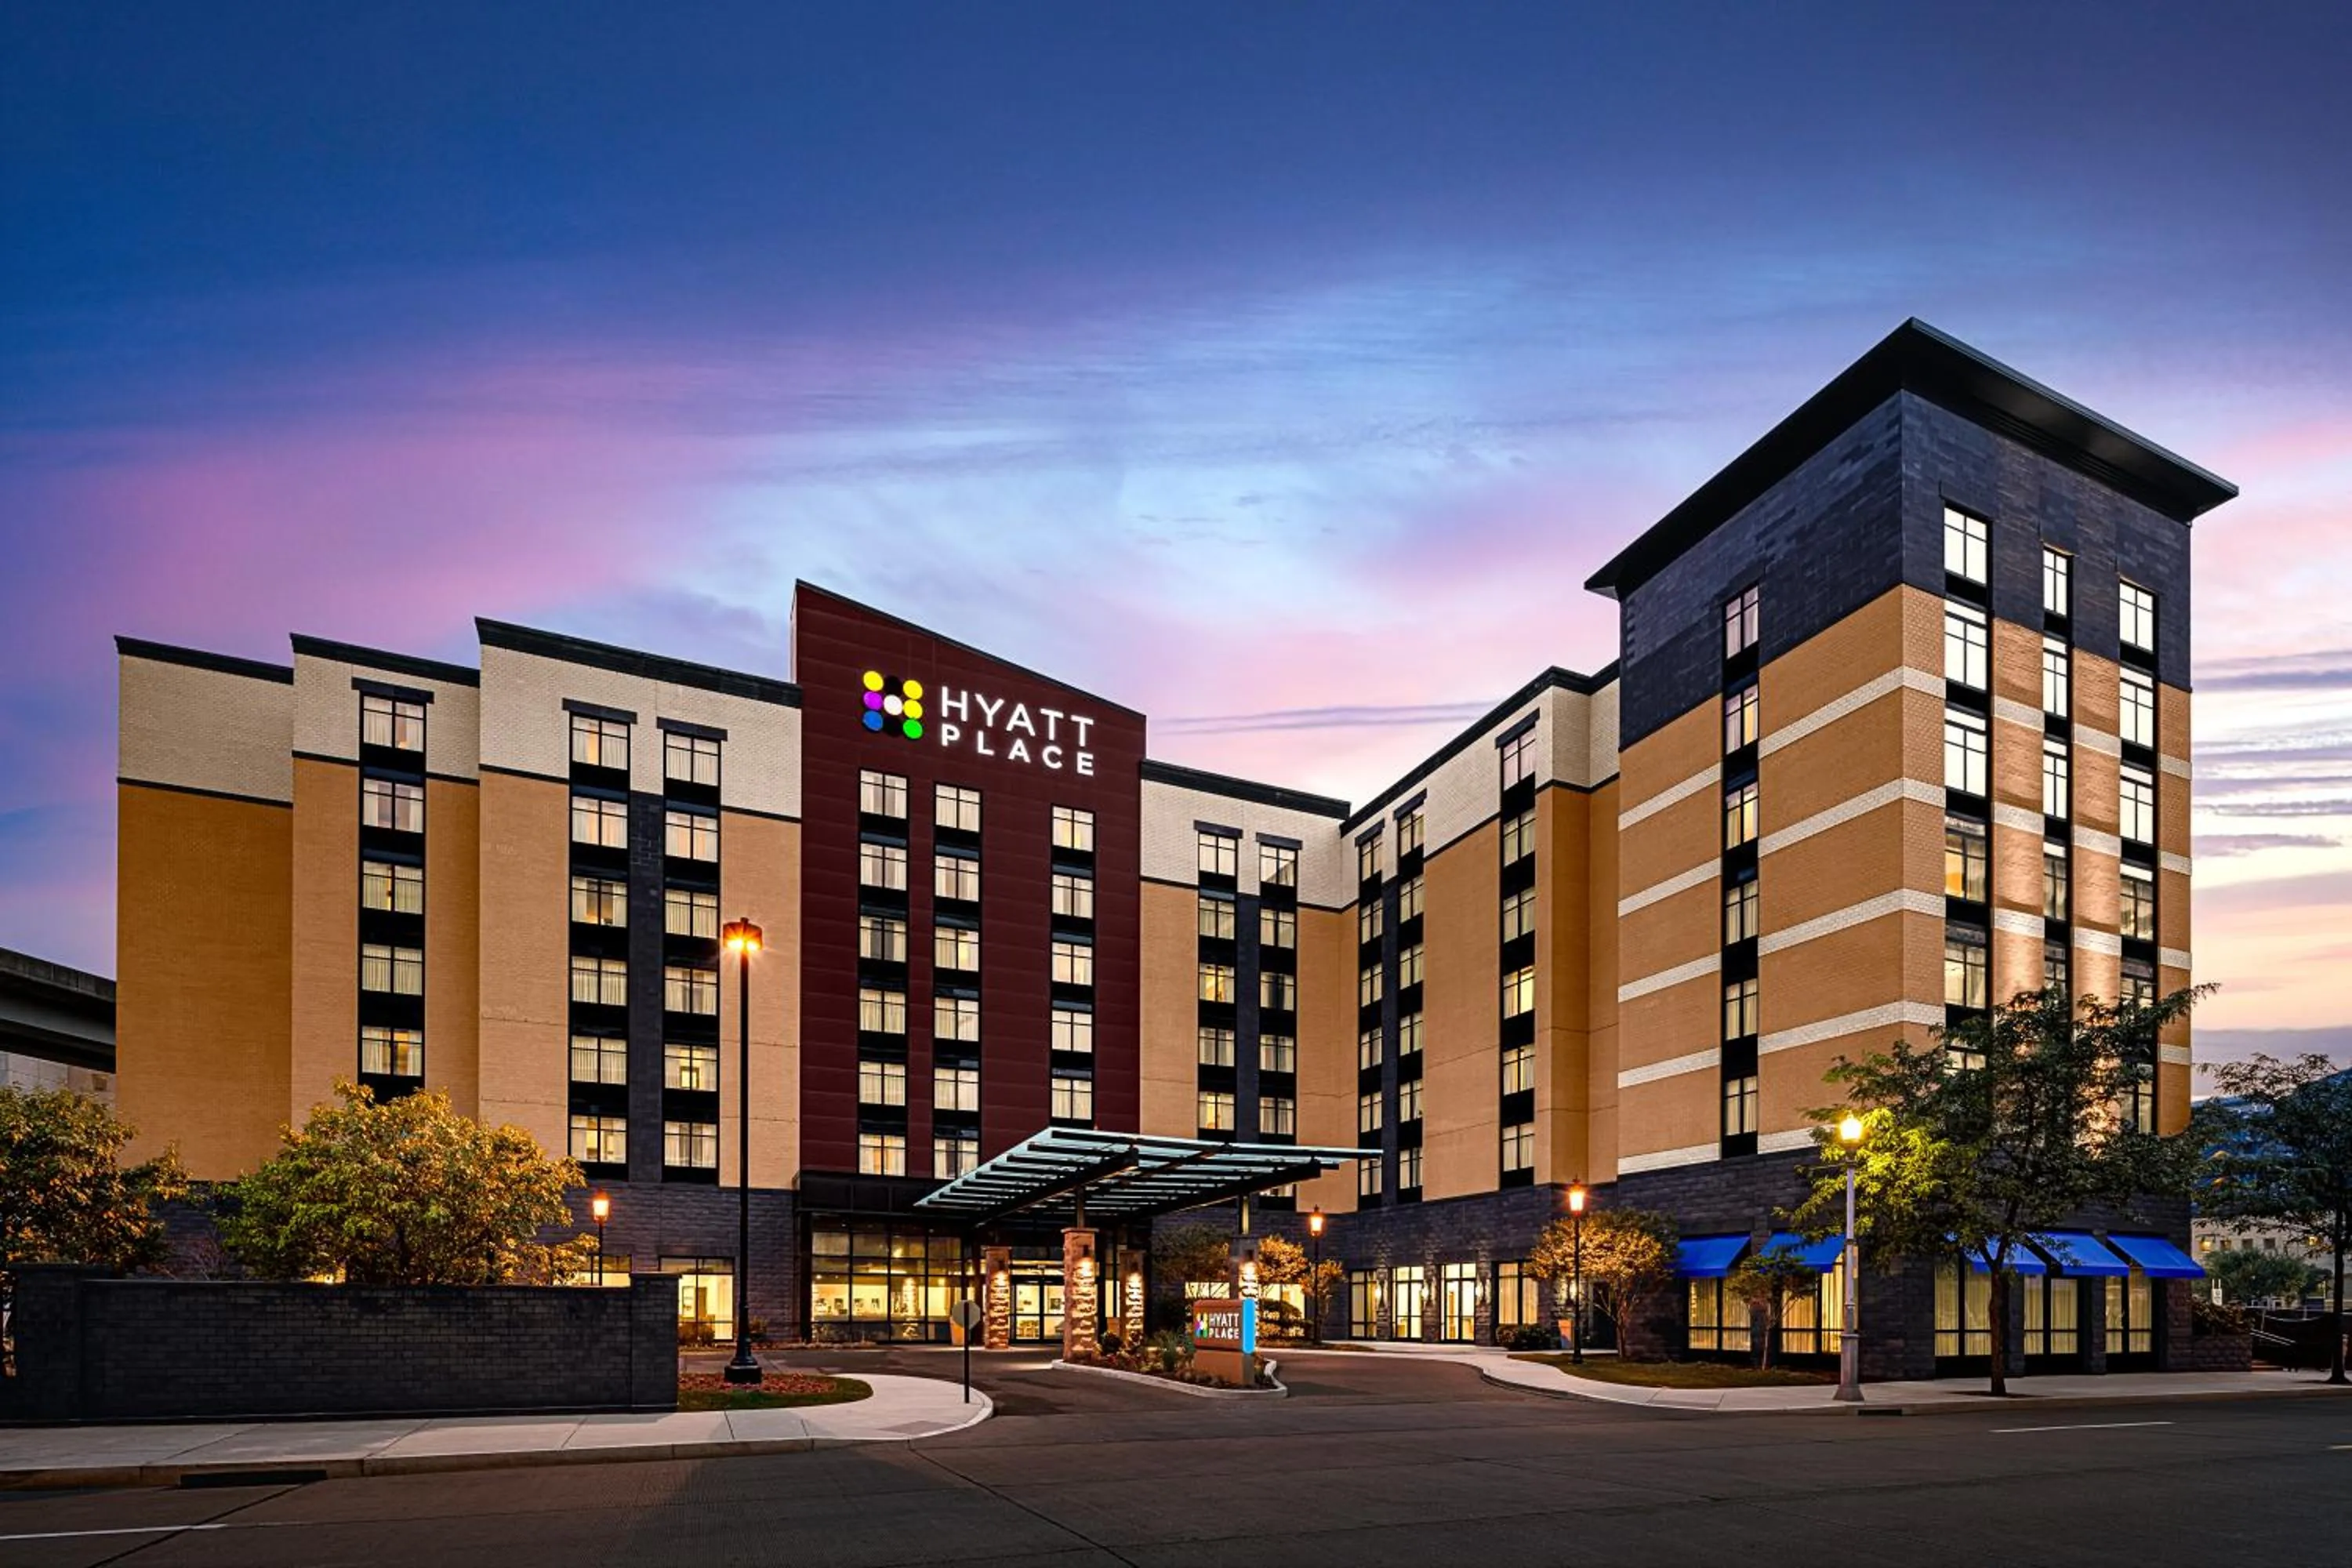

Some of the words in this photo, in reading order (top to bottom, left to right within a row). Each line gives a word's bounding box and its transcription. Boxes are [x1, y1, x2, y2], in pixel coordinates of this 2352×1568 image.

[941, 686, 1094, 747] HYATT
[941, 723, 1094, 776] PLACE
[1209, 1313, 1240, 1327] HYATT
[1209, 1328, 1240, 1339] PLACE
